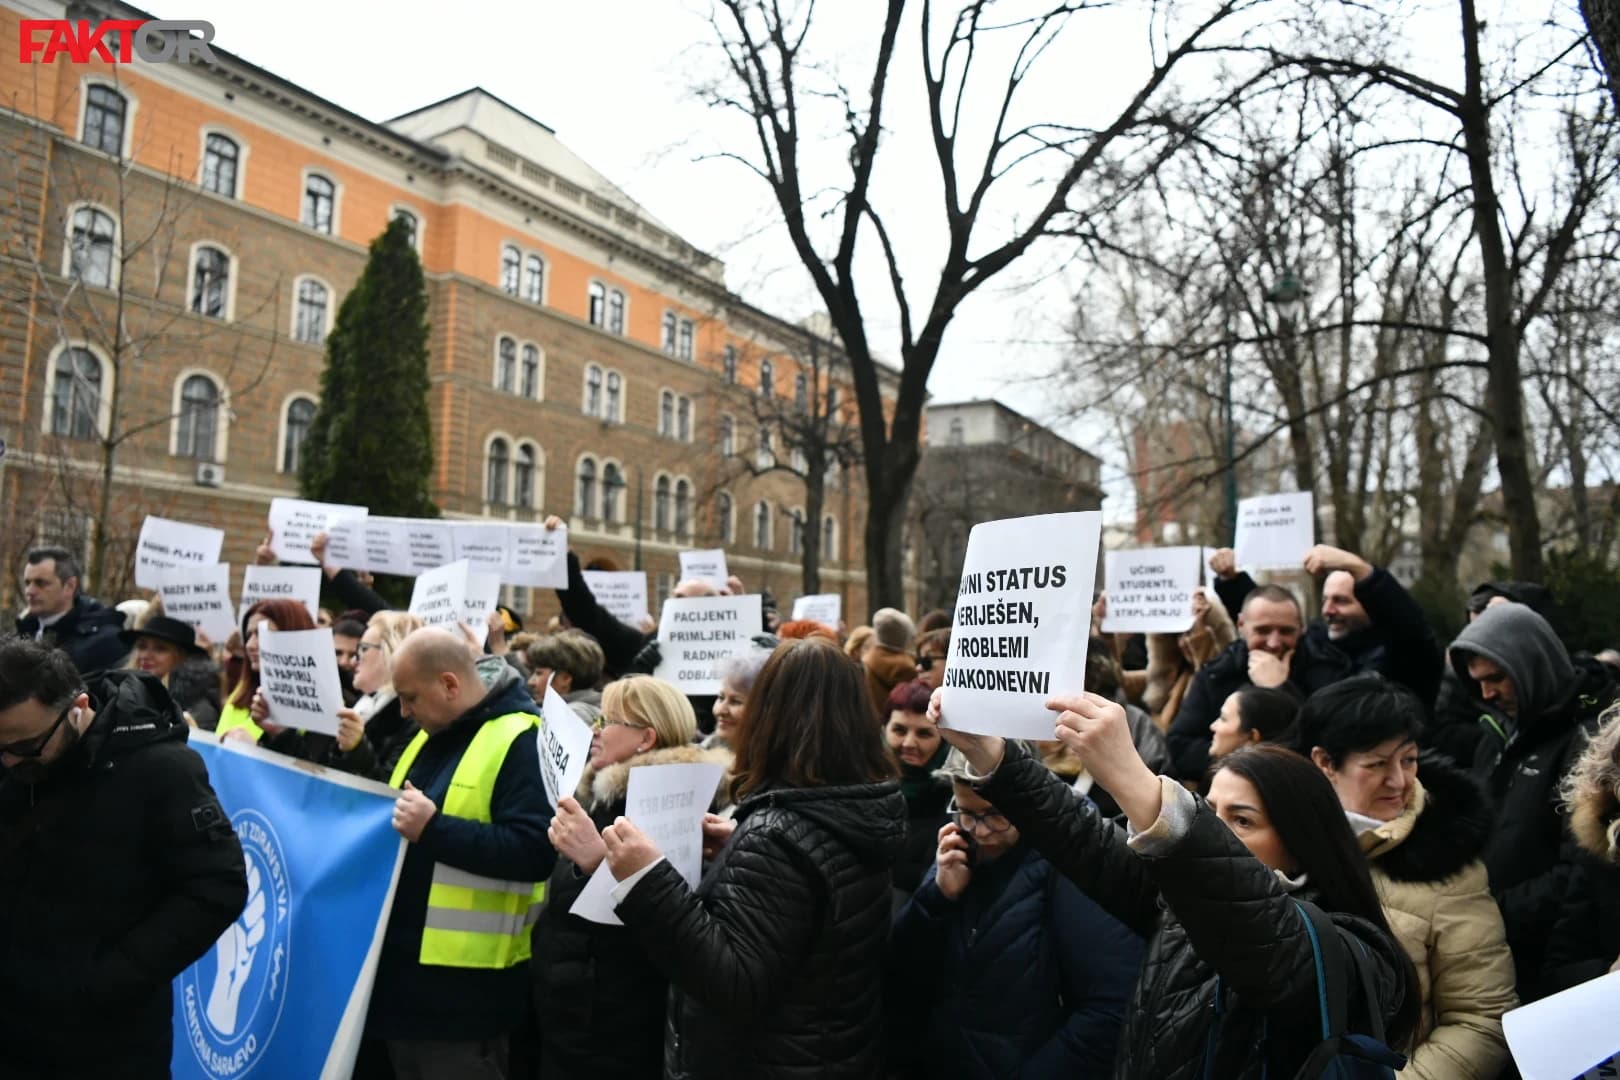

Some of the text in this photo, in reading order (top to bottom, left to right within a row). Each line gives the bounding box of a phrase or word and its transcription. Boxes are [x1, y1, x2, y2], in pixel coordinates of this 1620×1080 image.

[173, 548, 204, 562] PLATE
[986, 565, 1067, 592] STATUS
[674, 609, 738, 622] PACIJENTI
[669, 629, 736, 642] PRIMLJENI
[296, 685, 319, 699] BEZ
[945, 667, 1051, 695] SVAKODNEVNI
[272, 694, 324, 713] PRIMANJA
[548, 730, 570, 776] ZUBA
[249, 821, 287, 924] ZDRAVSTVA
[186, 984, 256, 1076] KANTONA SARAJEVO
